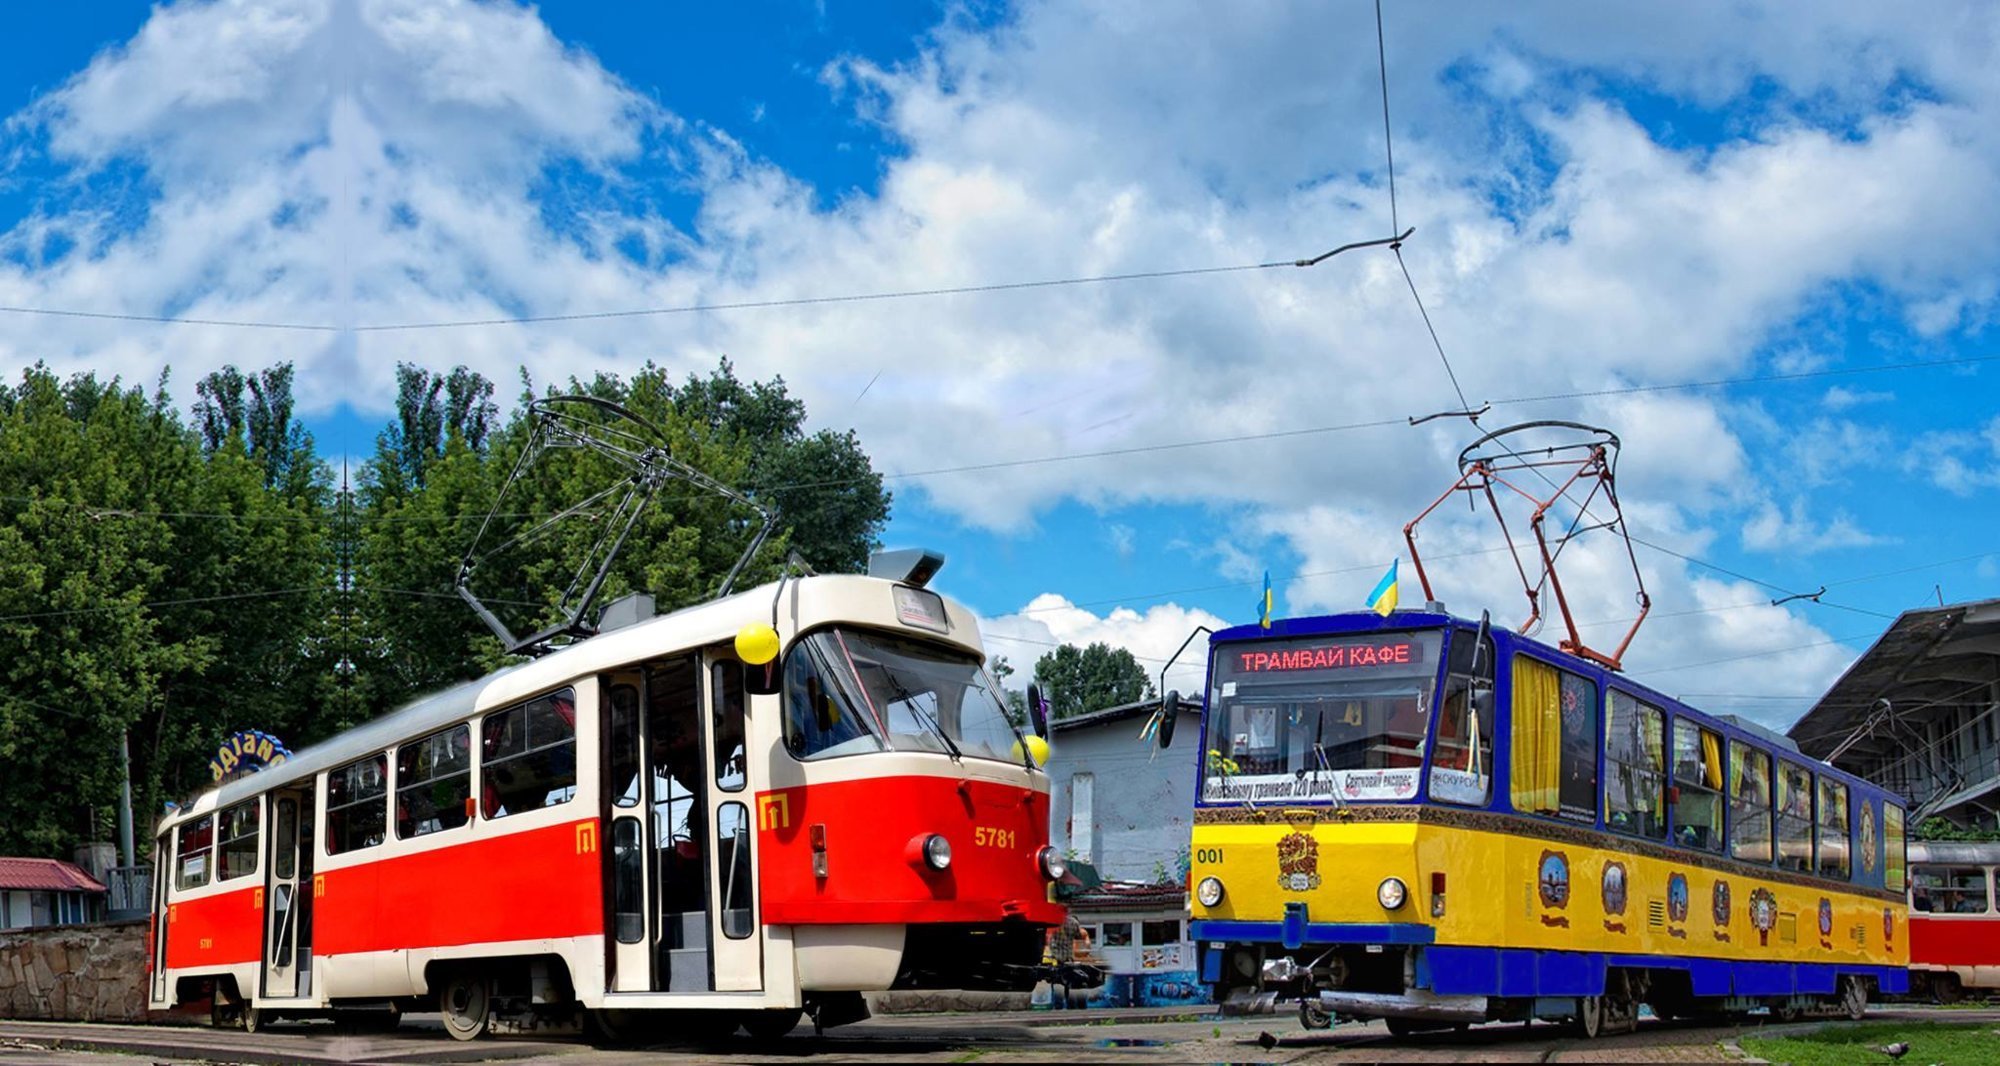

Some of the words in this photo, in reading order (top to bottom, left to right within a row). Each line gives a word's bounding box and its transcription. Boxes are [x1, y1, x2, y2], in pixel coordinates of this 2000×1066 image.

[1241, 646, 1344, 672] ТРАМВАЙ
[1350, 644, 1409, 666] КАФЕ
[1294, 777, 1309, 797] 120
[975, 826, 1015, 849] 5781
[1197, 849, 1223, 863] 001
